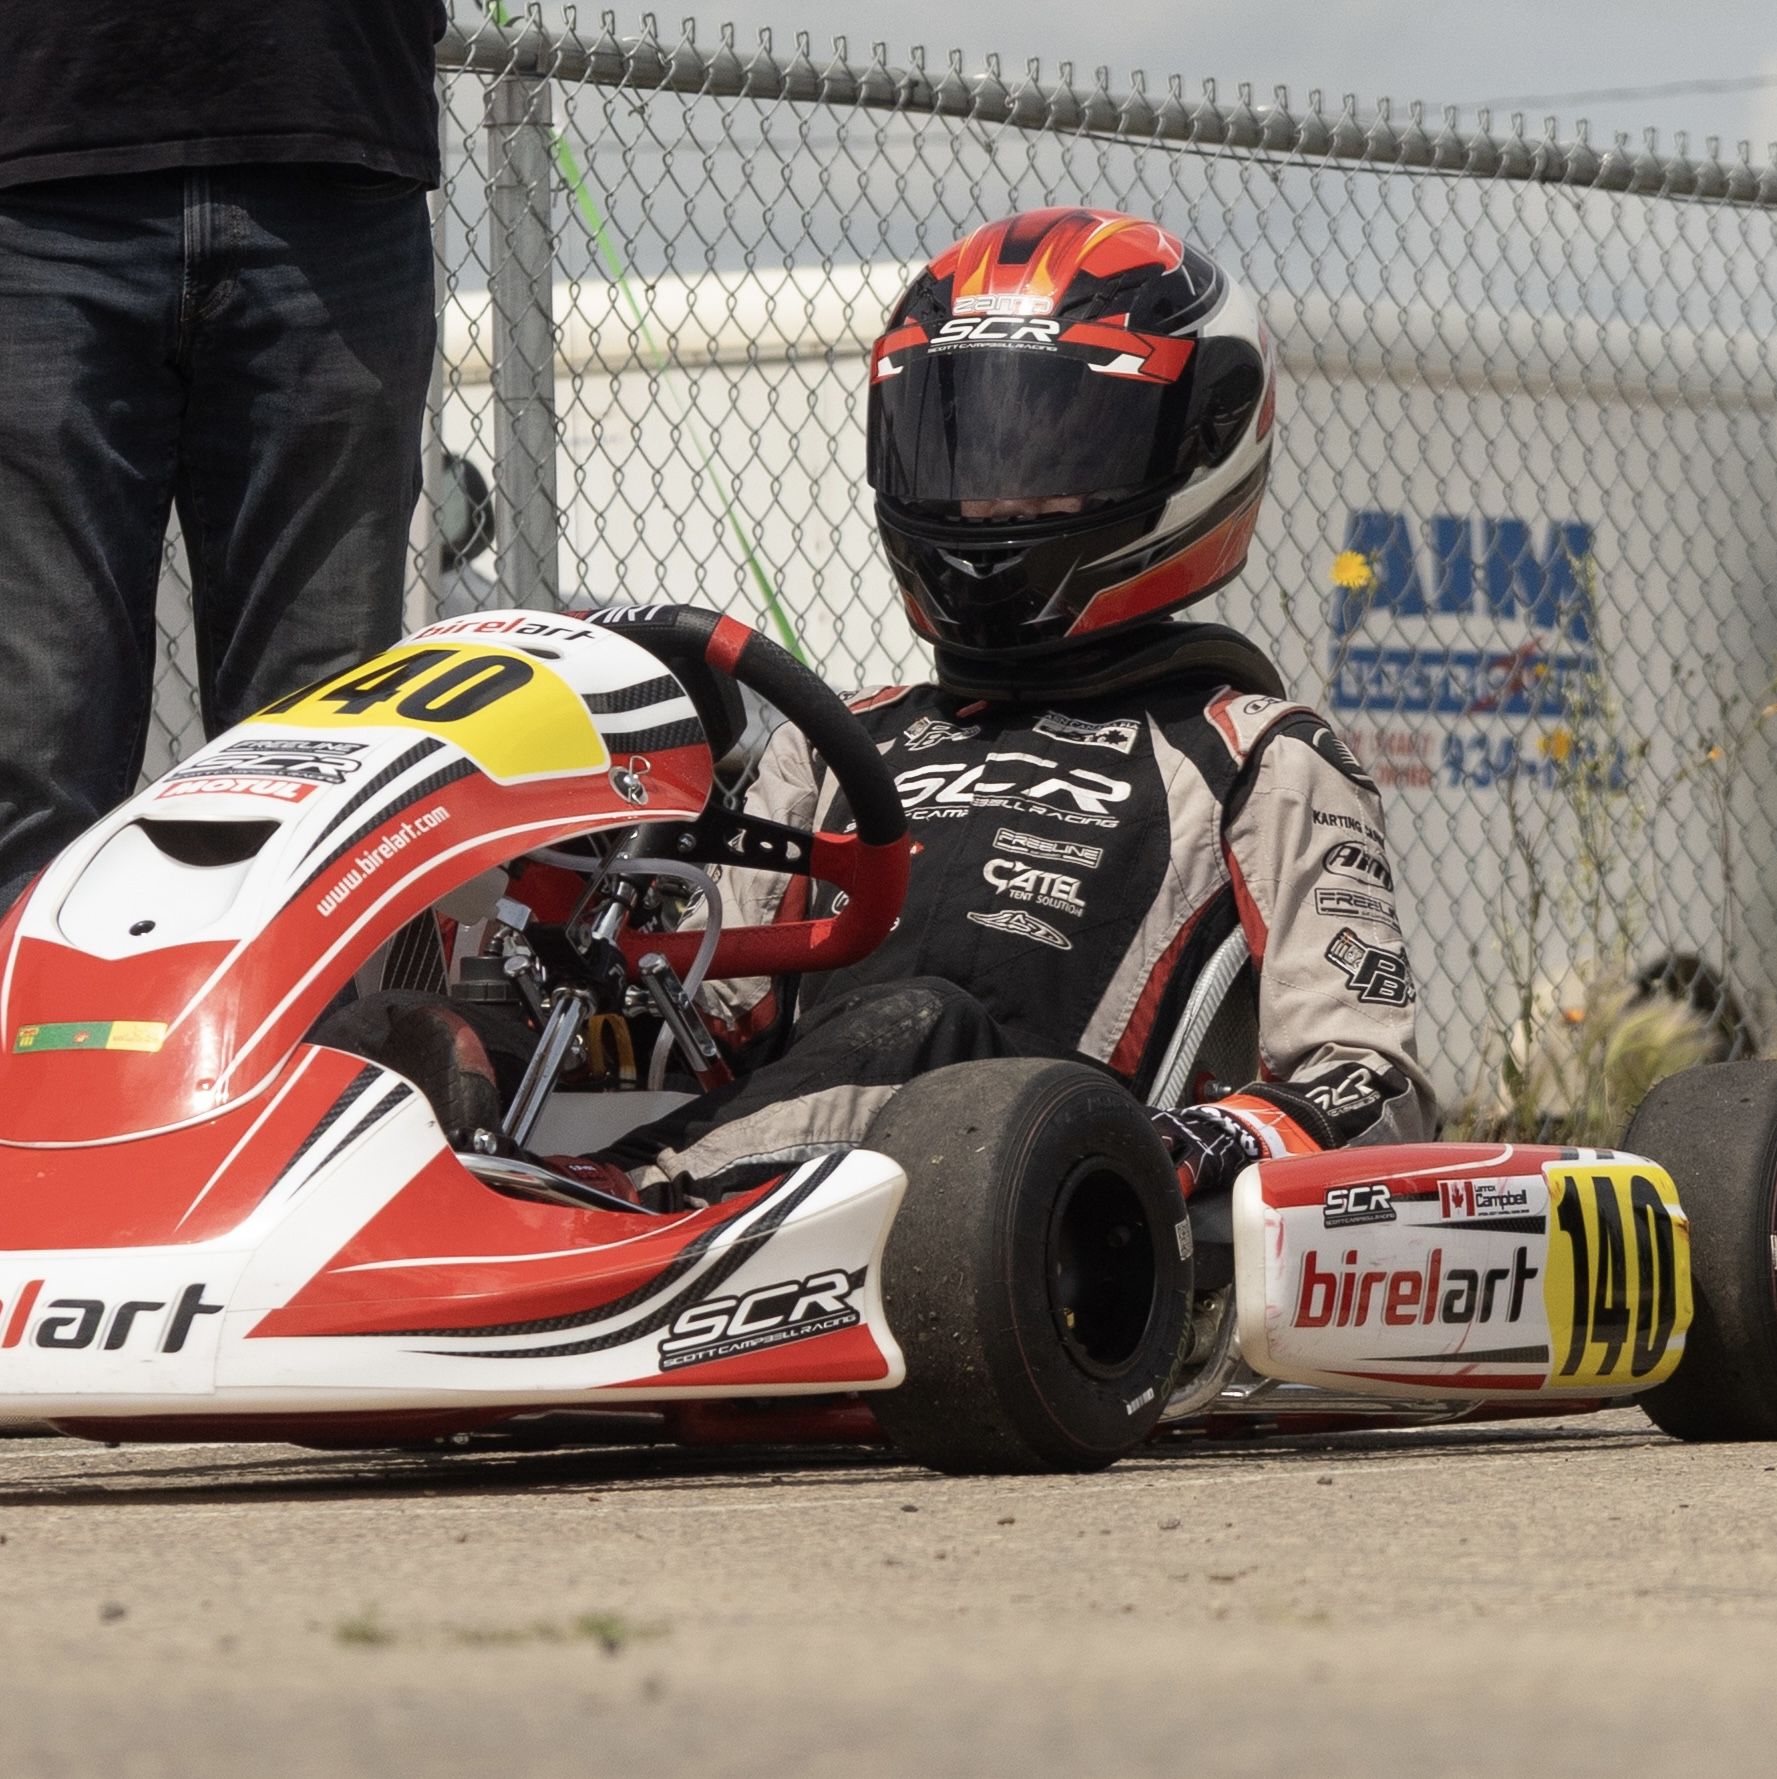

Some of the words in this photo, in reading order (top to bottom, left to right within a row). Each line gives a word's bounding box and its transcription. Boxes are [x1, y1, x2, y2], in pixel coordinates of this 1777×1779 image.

[930, 316, 1060, 343] SCR
[256, 649, 535, 723] 140
[163, 778, 301, 799] MOTUL
[894, 752, 1132, 814] SCR
[1312, 810, 1363, 833] KARTING
[316, 806, 451, 917] www.birelart.com
[998, 831, 1100, 861] FREELINE
[1009, 889, 1035, 902] TENT
[1036, 894, 1084, 918] SOLUTION
[1325, 1184, 1391, 1216] SCR
[1476, 1189, 1528, 1211] Campbell
[1292, 1245, 1539, 1328] birelart
[1557, 1174, 1677, 1378] 140
[0, 1279, 226, 1354] lart
[662, 1272, 850, 1351] SCR
